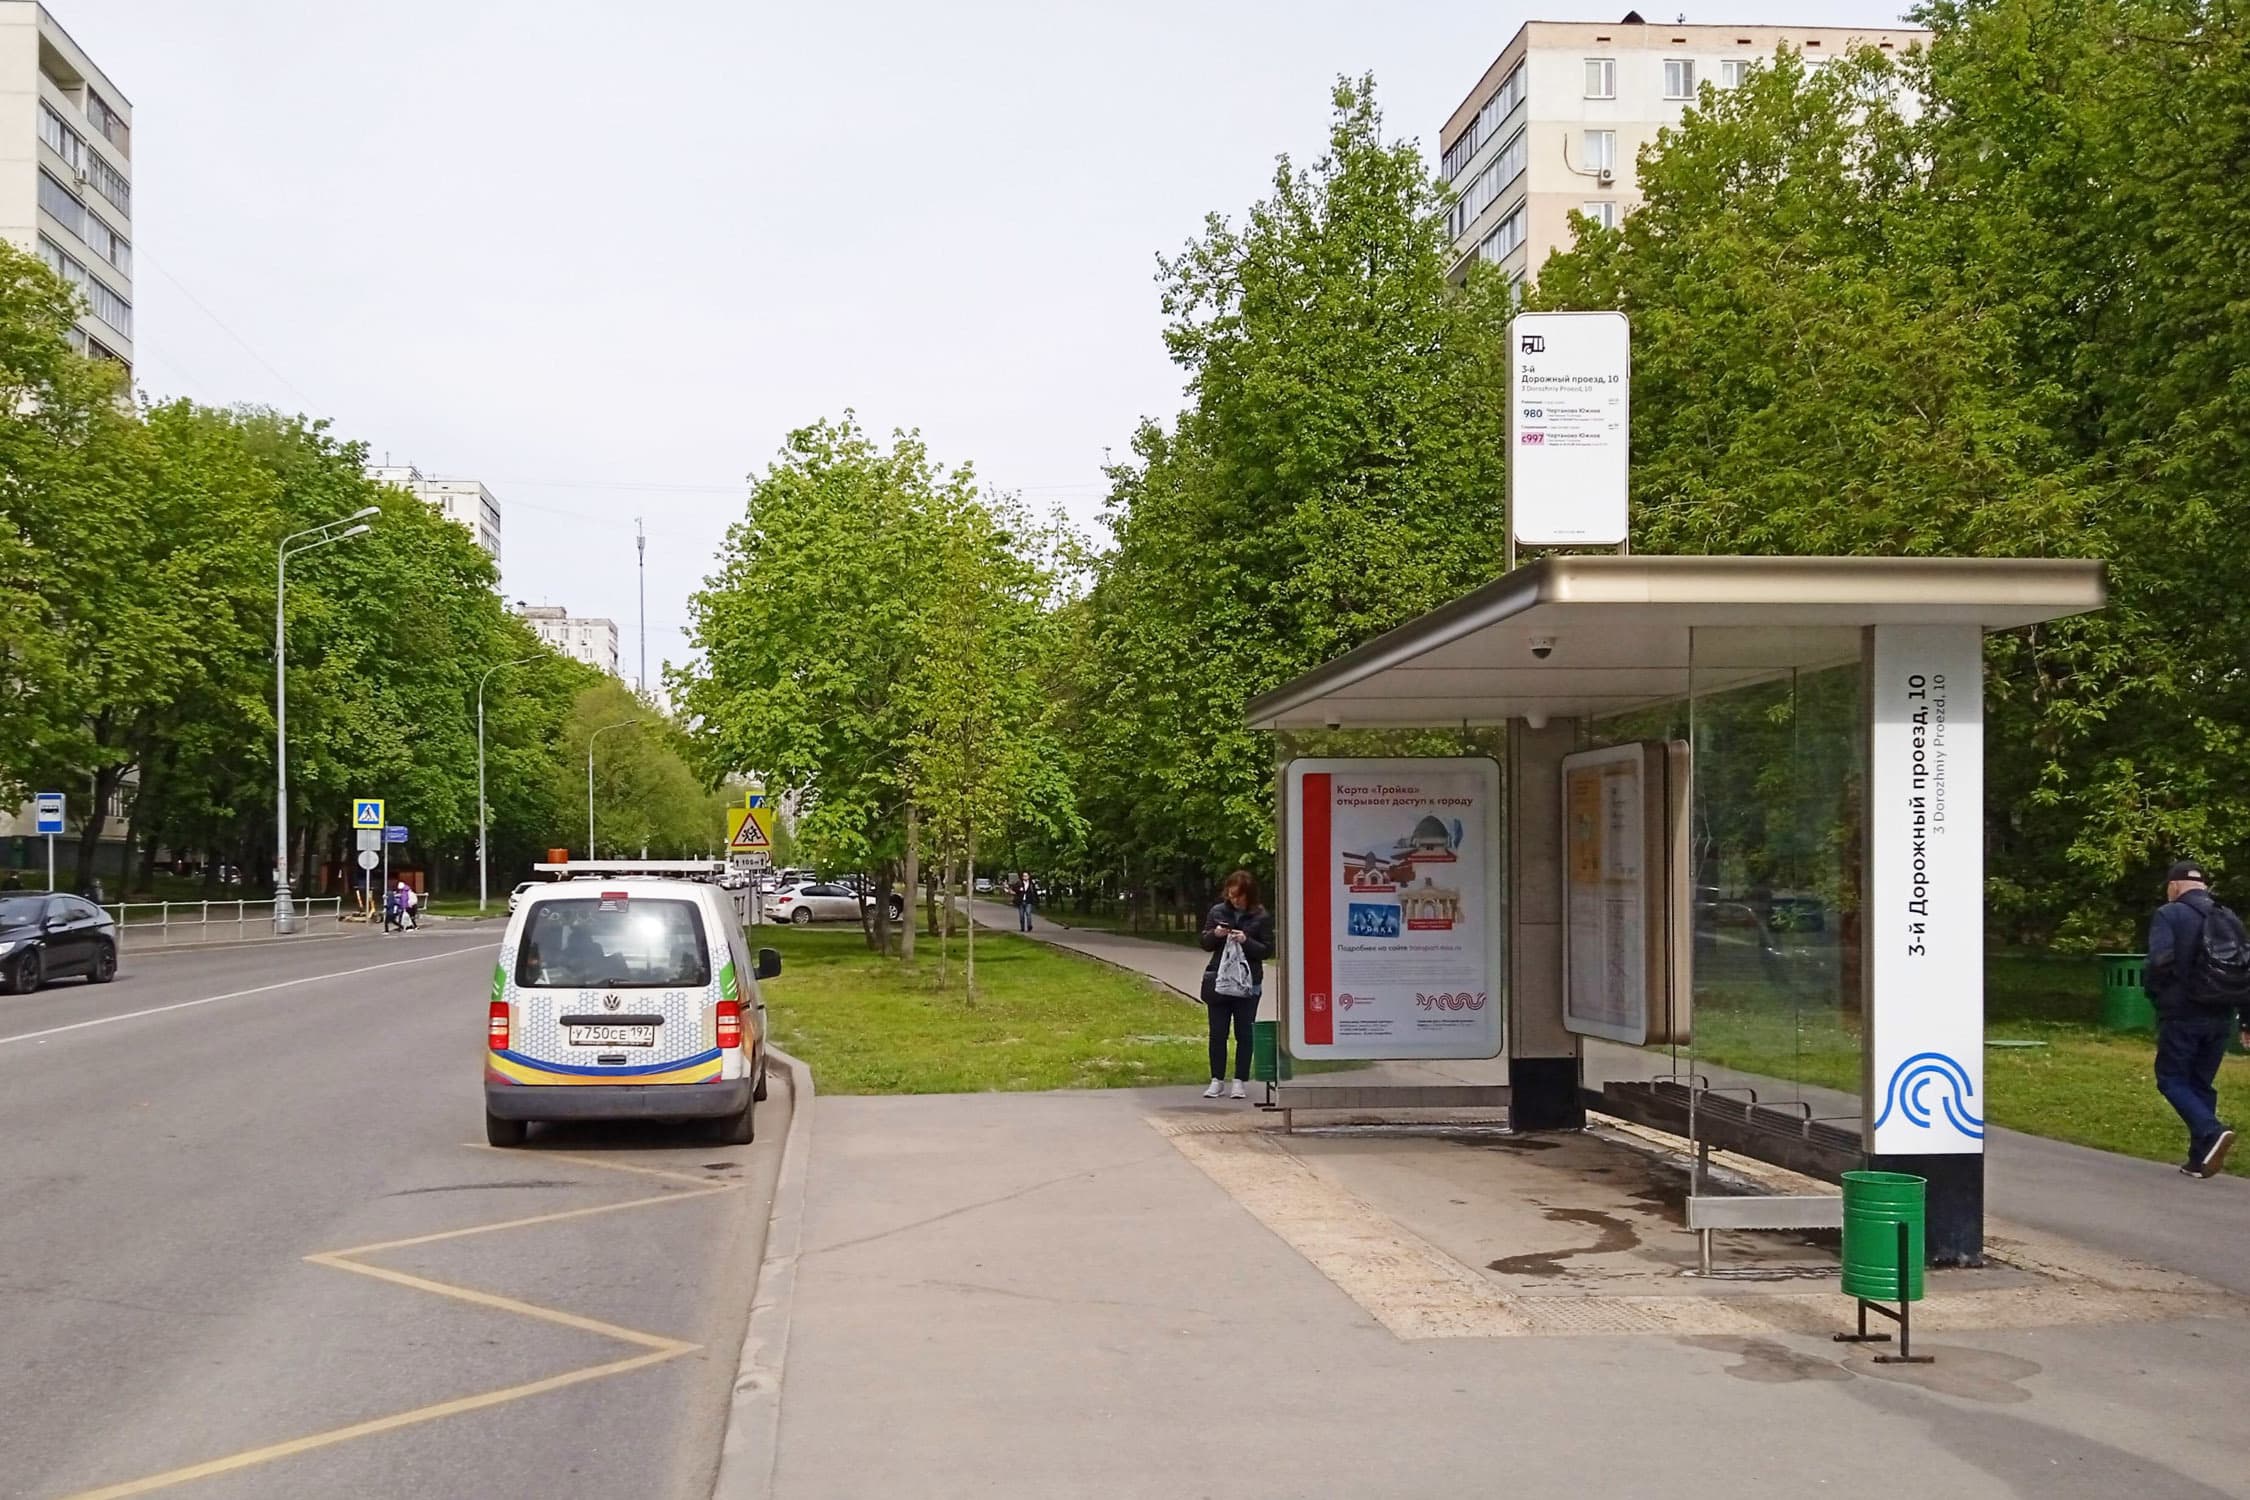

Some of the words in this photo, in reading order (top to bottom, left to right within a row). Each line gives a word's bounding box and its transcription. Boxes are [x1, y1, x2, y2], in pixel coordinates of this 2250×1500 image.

[1521, 374, 1570, 384] Дорожный
[1572, 375, 1606, 384] проезд,
[1608, 375, 1619, 383] 10
[1523, 409, 1543, 418] 980
[1909, 674, 1926, 700] 10
[1933, 674, 1945, 690] 10
[1933, 695, 1946, 747] Proezd,
[1912, 705, 1928, 789] проезд,
[1336, 785, 1369, 796] Карта
[1933, 751, 1947, 822] Dorozhniy
[1336, 797, 1390, 808] открывает
[1392, 797, 1427, 808] доступ
[1437, 797, 1473, 807] городу
[1933, 825, 1945, 834] 3
[1909, 797, 1928, 916] Дорожный
[1909, 923, 1925, 956] 3-й
